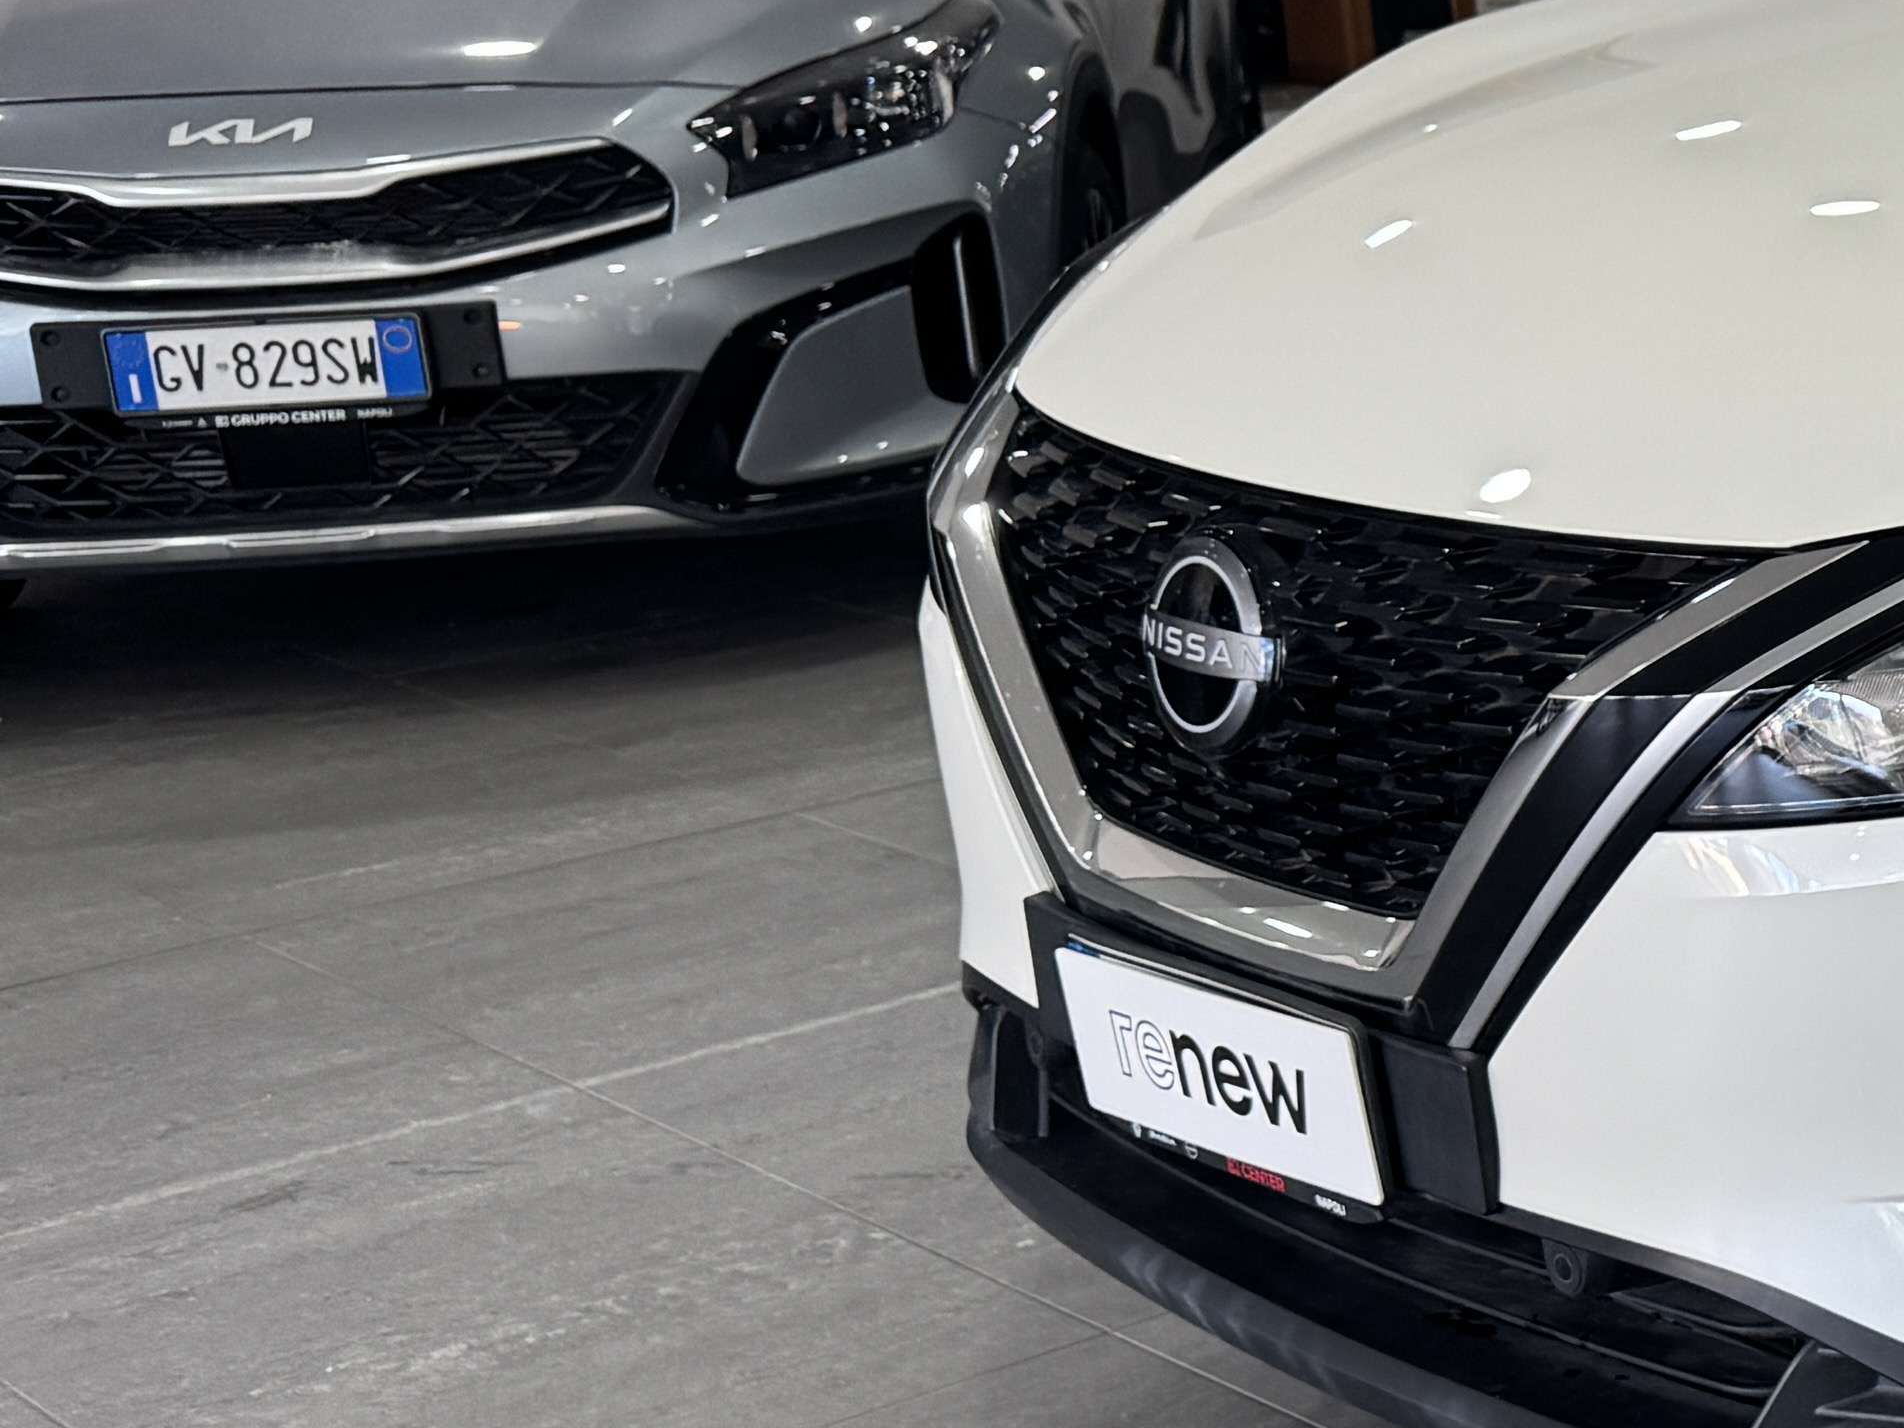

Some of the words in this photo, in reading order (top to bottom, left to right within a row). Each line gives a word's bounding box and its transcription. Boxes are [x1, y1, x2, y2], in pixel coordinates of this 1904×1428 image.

[168, 117, 313, 147] KIA
[230, 411, 289, 427] GRUPPO
[291, 409, 346, 424] CENTER
[1142, 614, 1264, 674] NISSAN
[1109, 1010, 1307, 1135] renew
